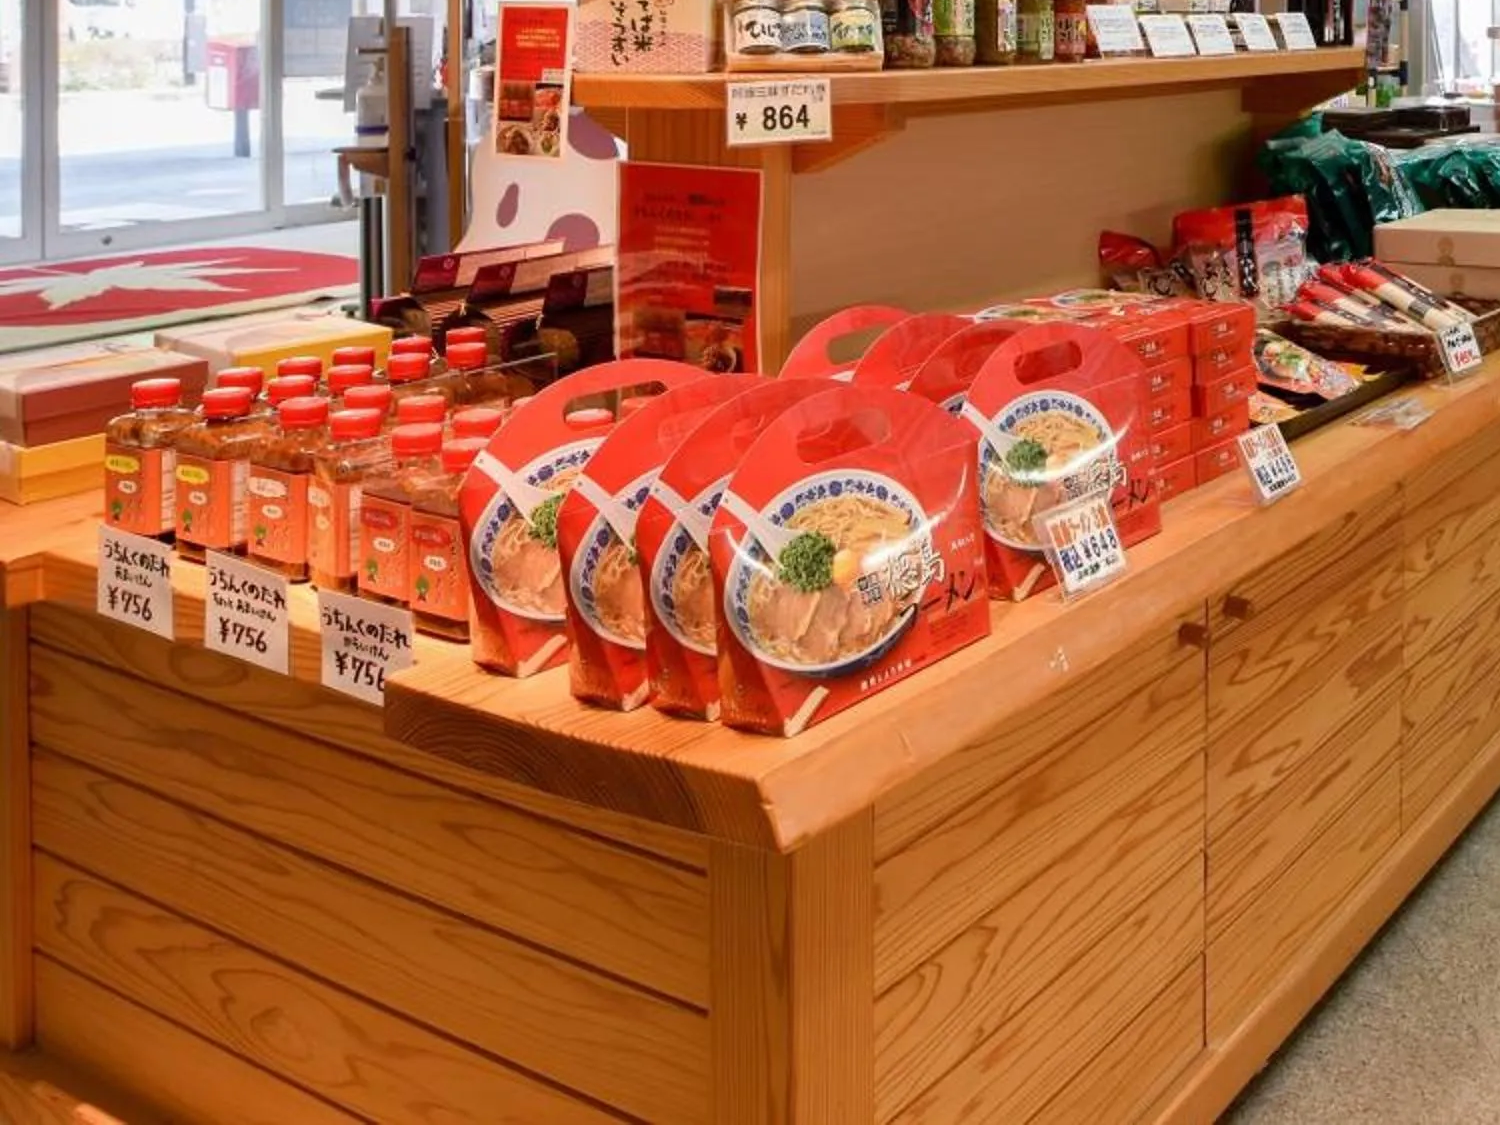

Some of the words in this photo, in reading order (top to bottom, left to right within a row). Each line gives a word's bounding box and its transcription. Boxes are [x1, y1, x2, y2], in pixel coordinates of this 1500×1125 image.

[735, 112, 748, 131] ¥
[763, 104, 811, 131] 864
[103, 539, 171, 577] うちんくのたれ
[107, 584, 152, 621] ¥756
[210, 566, 288, 610] うちんくのたれ
[219, 616, 267, 653] ¥756
[321, 606, 412, 650] うちんくのたれ
